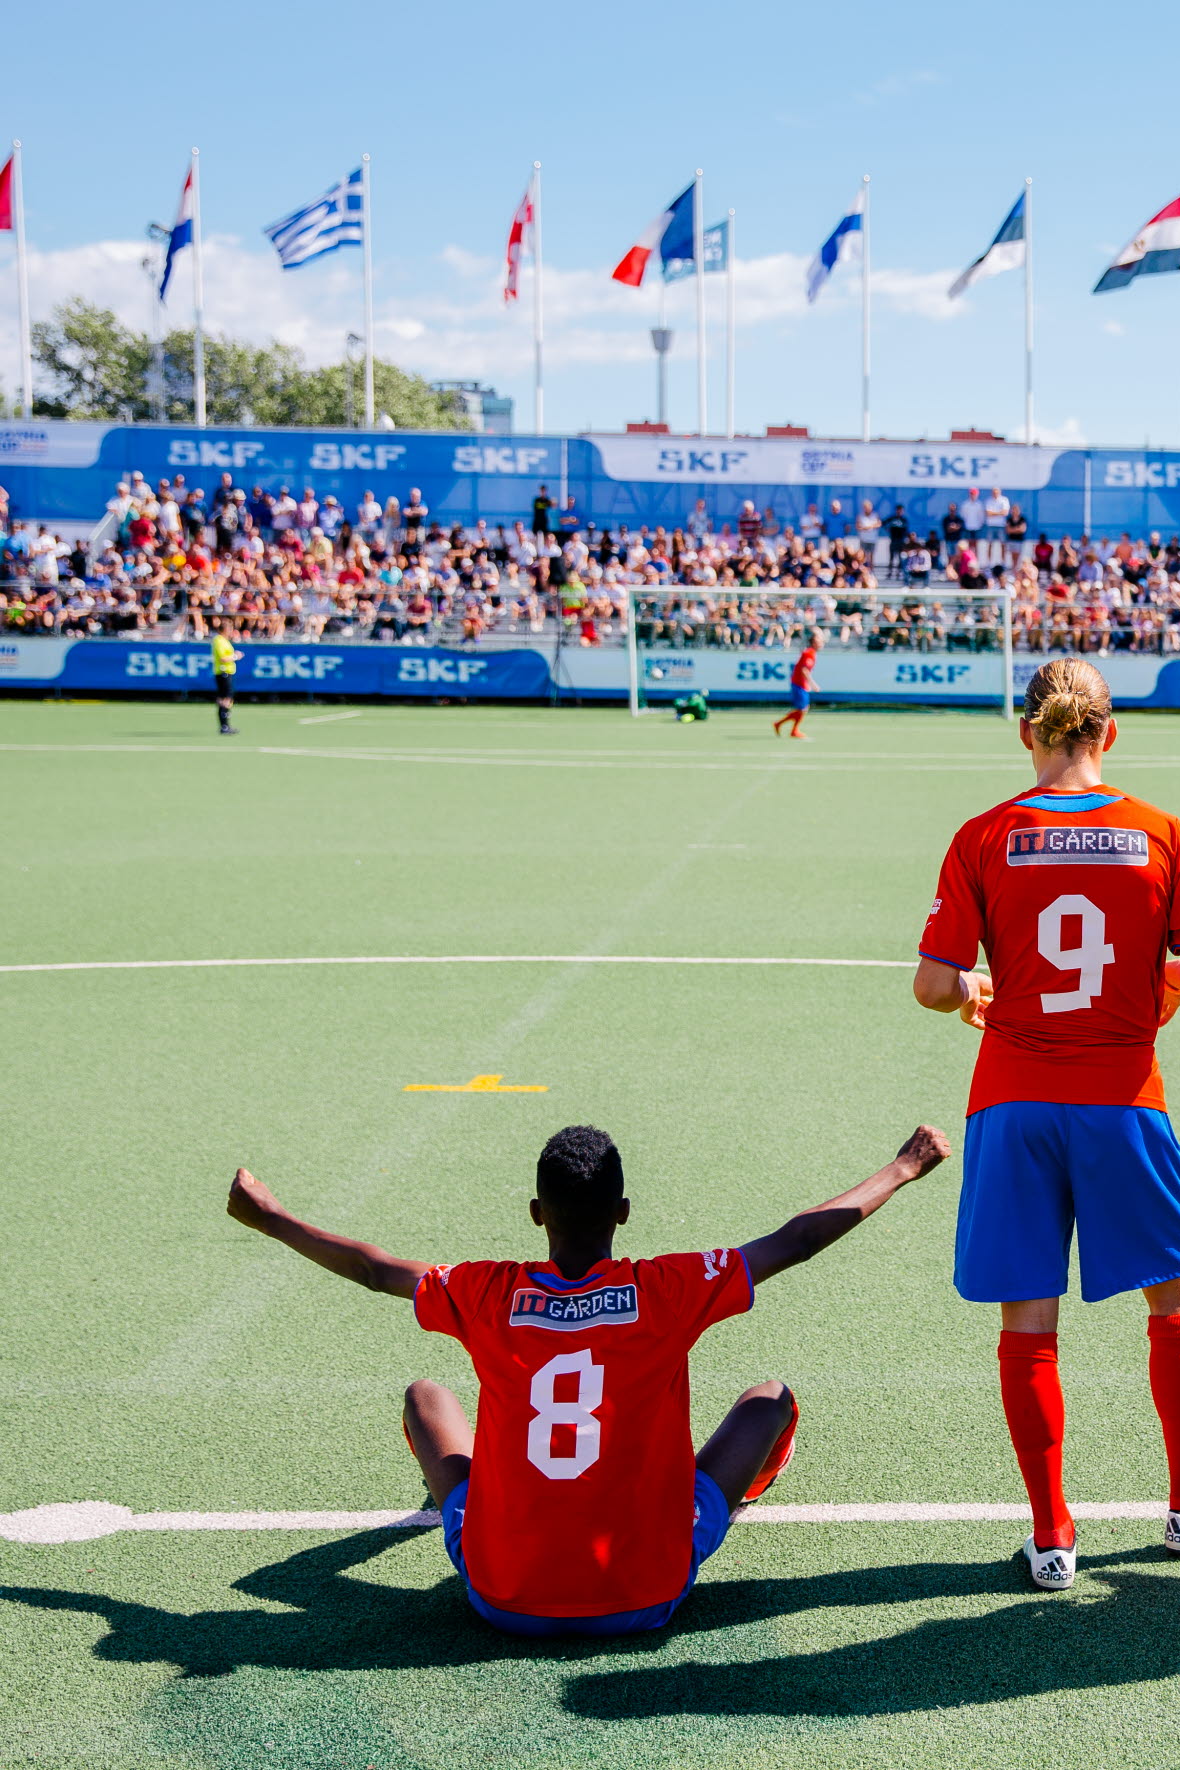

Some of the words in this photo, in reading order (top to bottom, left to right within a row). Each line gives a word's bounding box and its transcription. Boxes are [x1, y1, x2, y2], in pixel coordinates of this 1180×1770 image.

[168, 440, 264, 467] SKF
[309, 443, 406, 470] SKF
[452, 446, 548, 474] SKF
[657, 450, 747, 473] SKF
[909, 455, 998, 478] SKF
[253, 655, 343, 679] SKF
[398, 658, 487, 683] SKF
[737, 662, 795, 680] SK
[896, 664, 970, 684] SKF
[1013, 833, 1041, 851] IT
[1049, 829, 1142, 852] GÅRDEN
[1037, 894, 1116, 1013] 9
[516, 1293, 545, 1313] IT
[549, 1290, 632, 1319] GÅRDEN
[527, 1348, 605, 1480] 8
[1036, 1570, 1073, 1581] adidas
